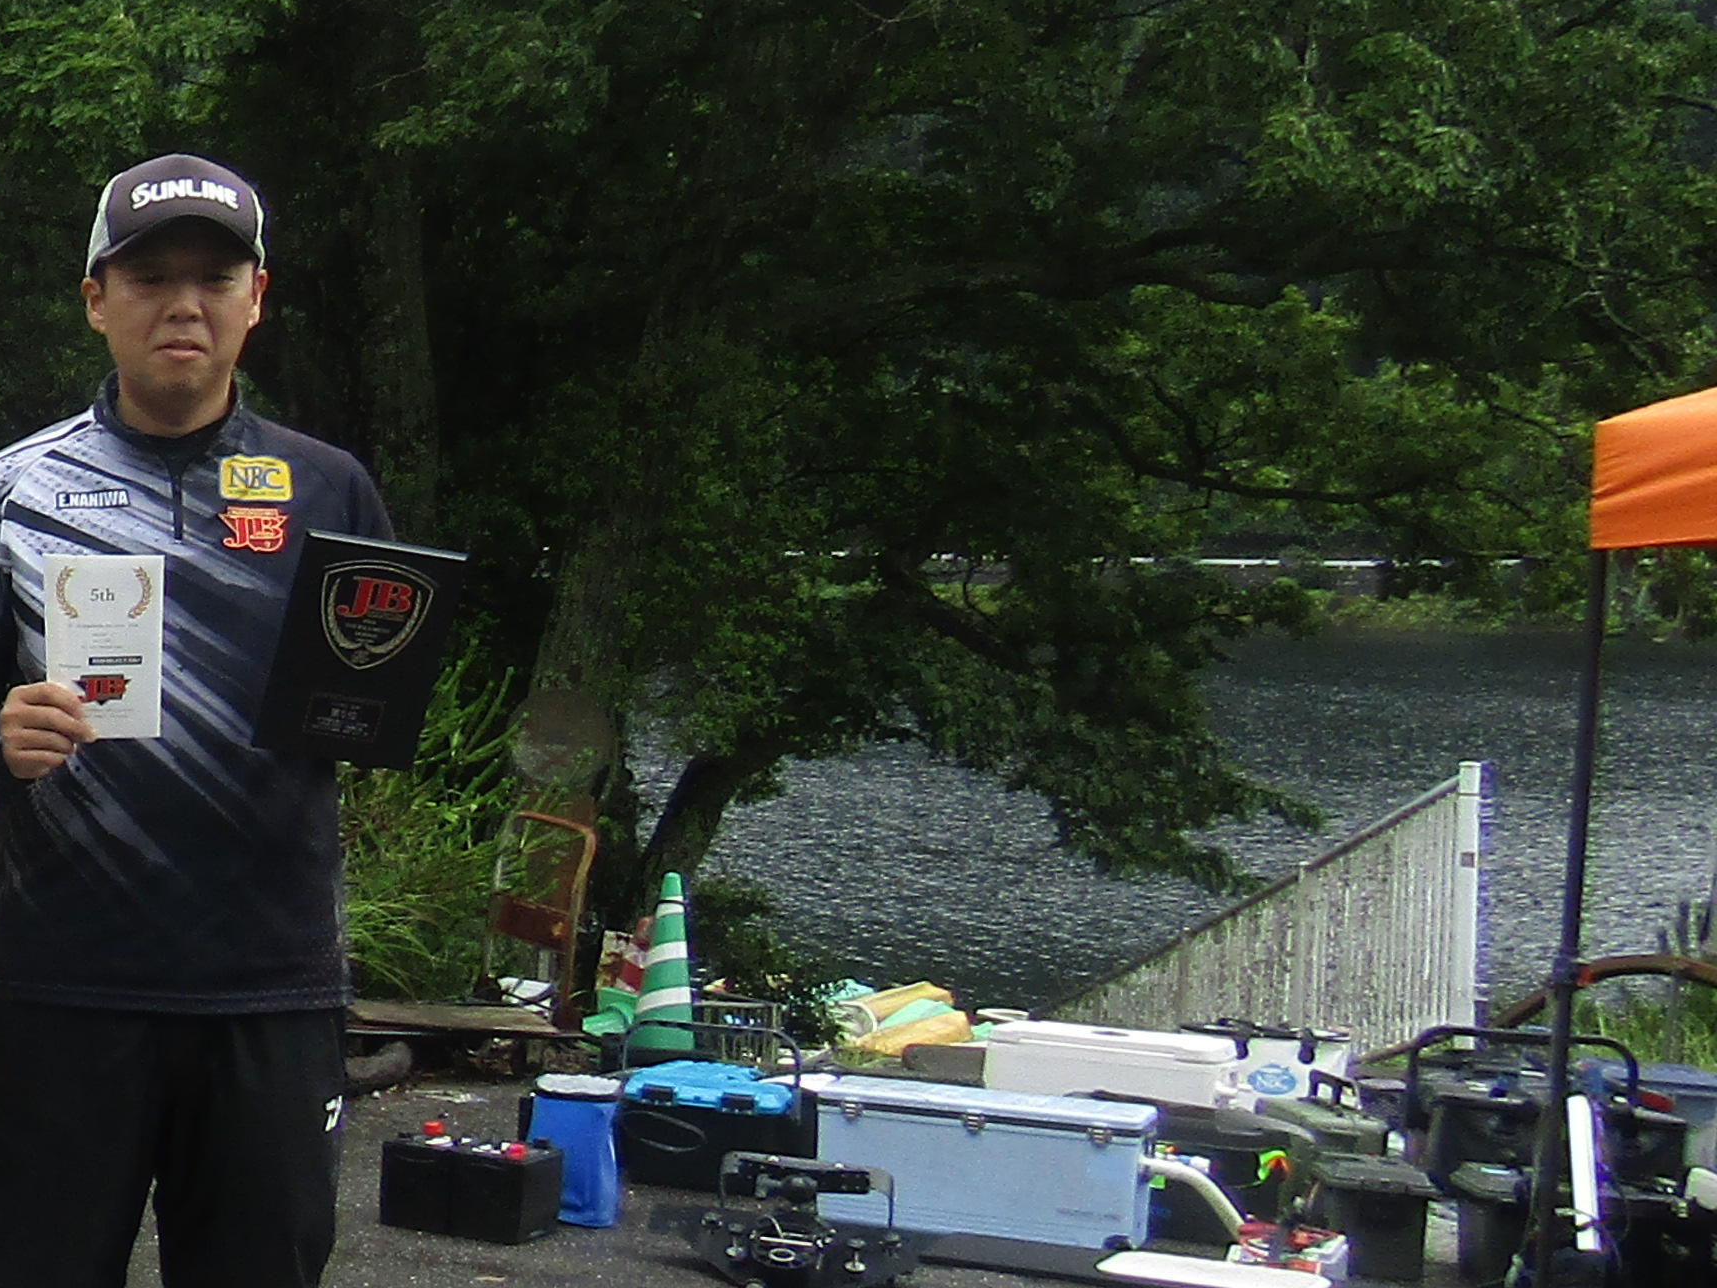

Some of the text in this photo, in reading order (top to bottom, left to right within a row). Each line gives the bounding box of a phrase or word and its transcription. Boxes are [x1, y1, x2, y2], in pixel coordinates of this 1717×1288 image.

[130, 178, 240, 210] SUNLINE
[228, 464, 286, 490] NBC
[90, 588, 116, 603] 5th
[336, 575, 413, 619] JB
